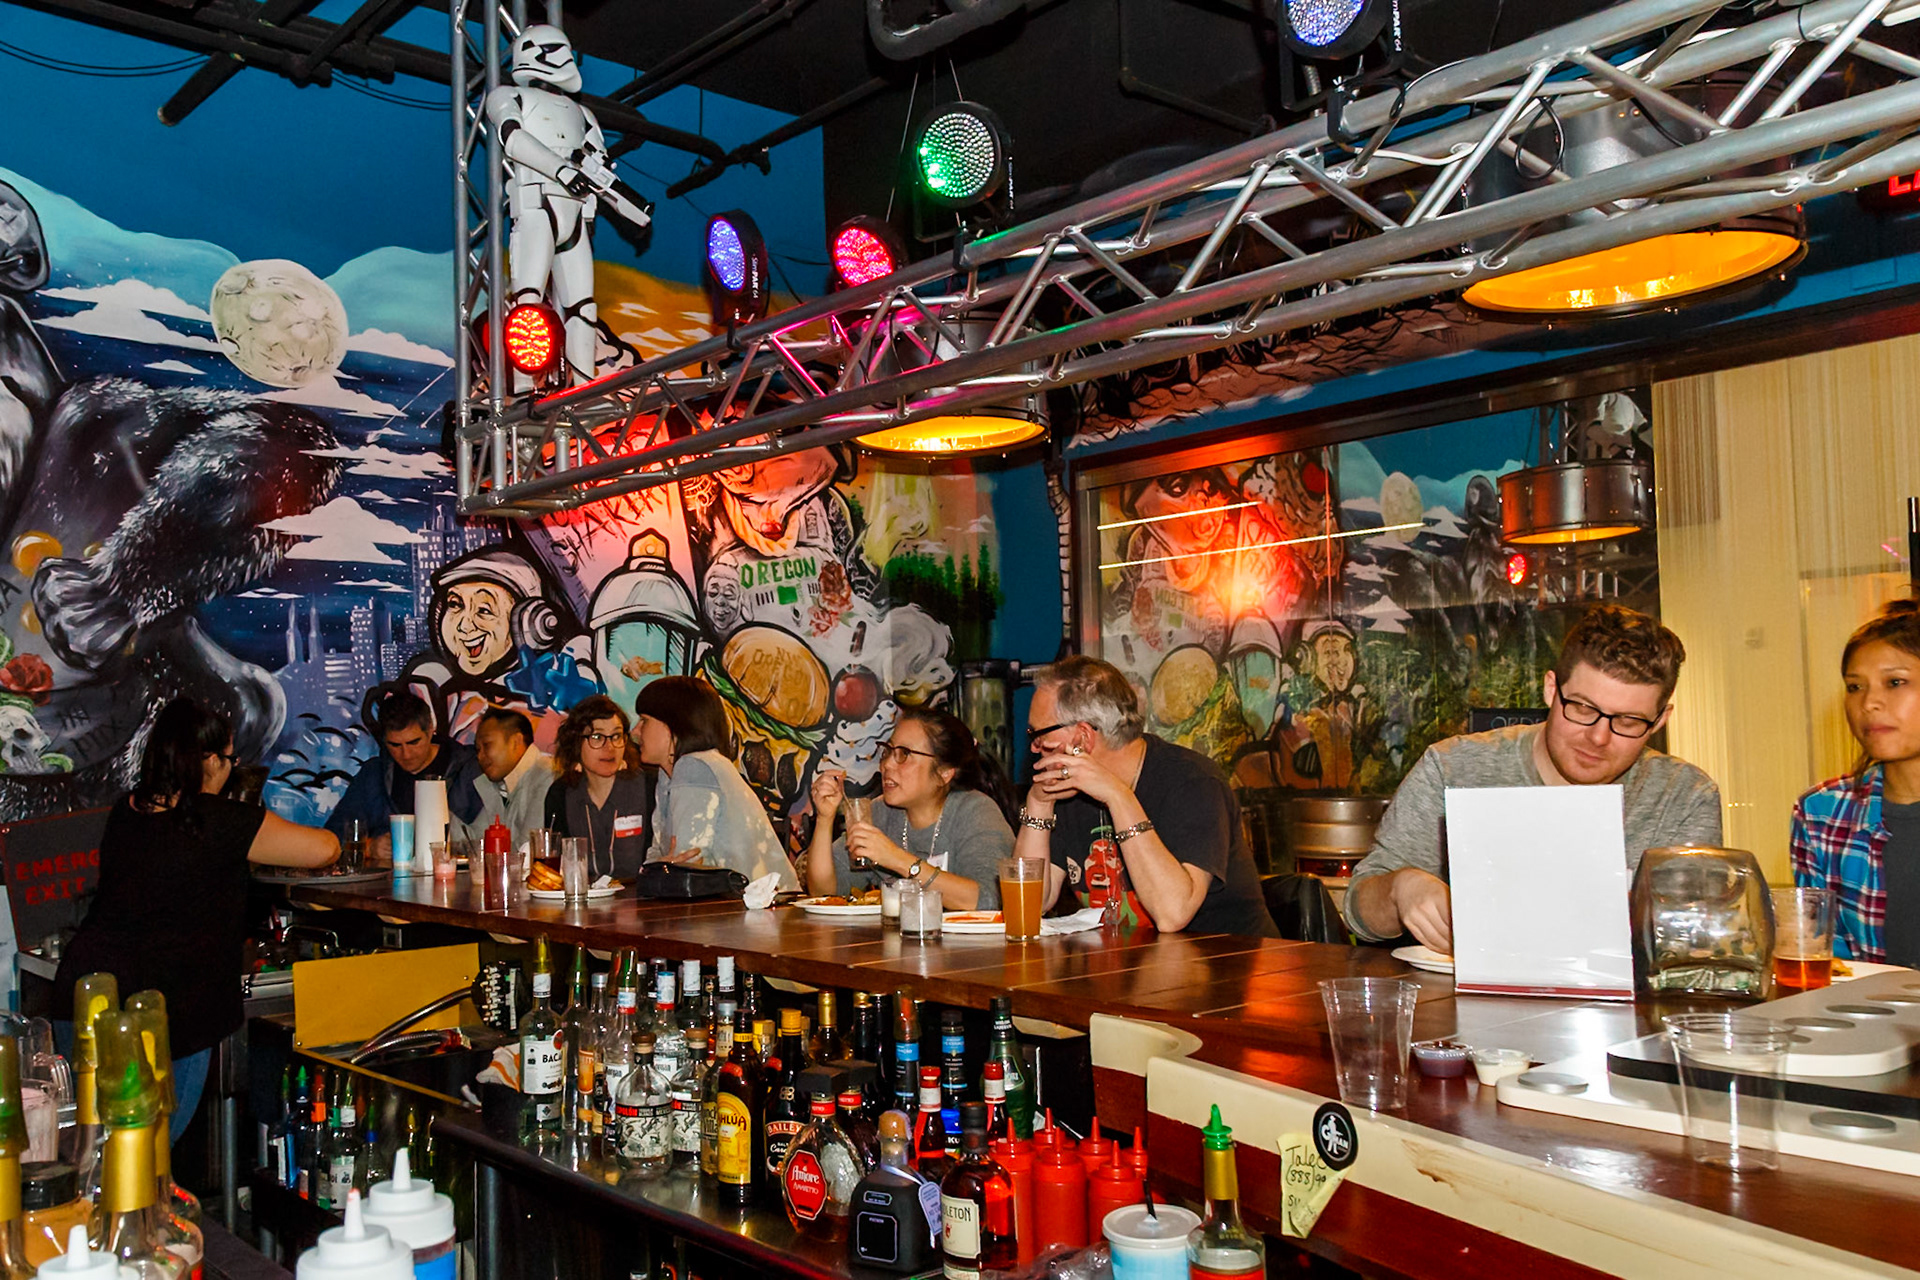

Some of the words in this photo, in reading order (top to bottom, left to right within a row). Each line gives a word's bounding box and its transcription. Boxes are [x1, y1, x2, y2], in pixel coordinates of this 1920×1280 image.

[741, 556, 818, 590] OREGON
[25, 876, 86, 905] EXIT
[791, 1165, 820, 1185] Amore
